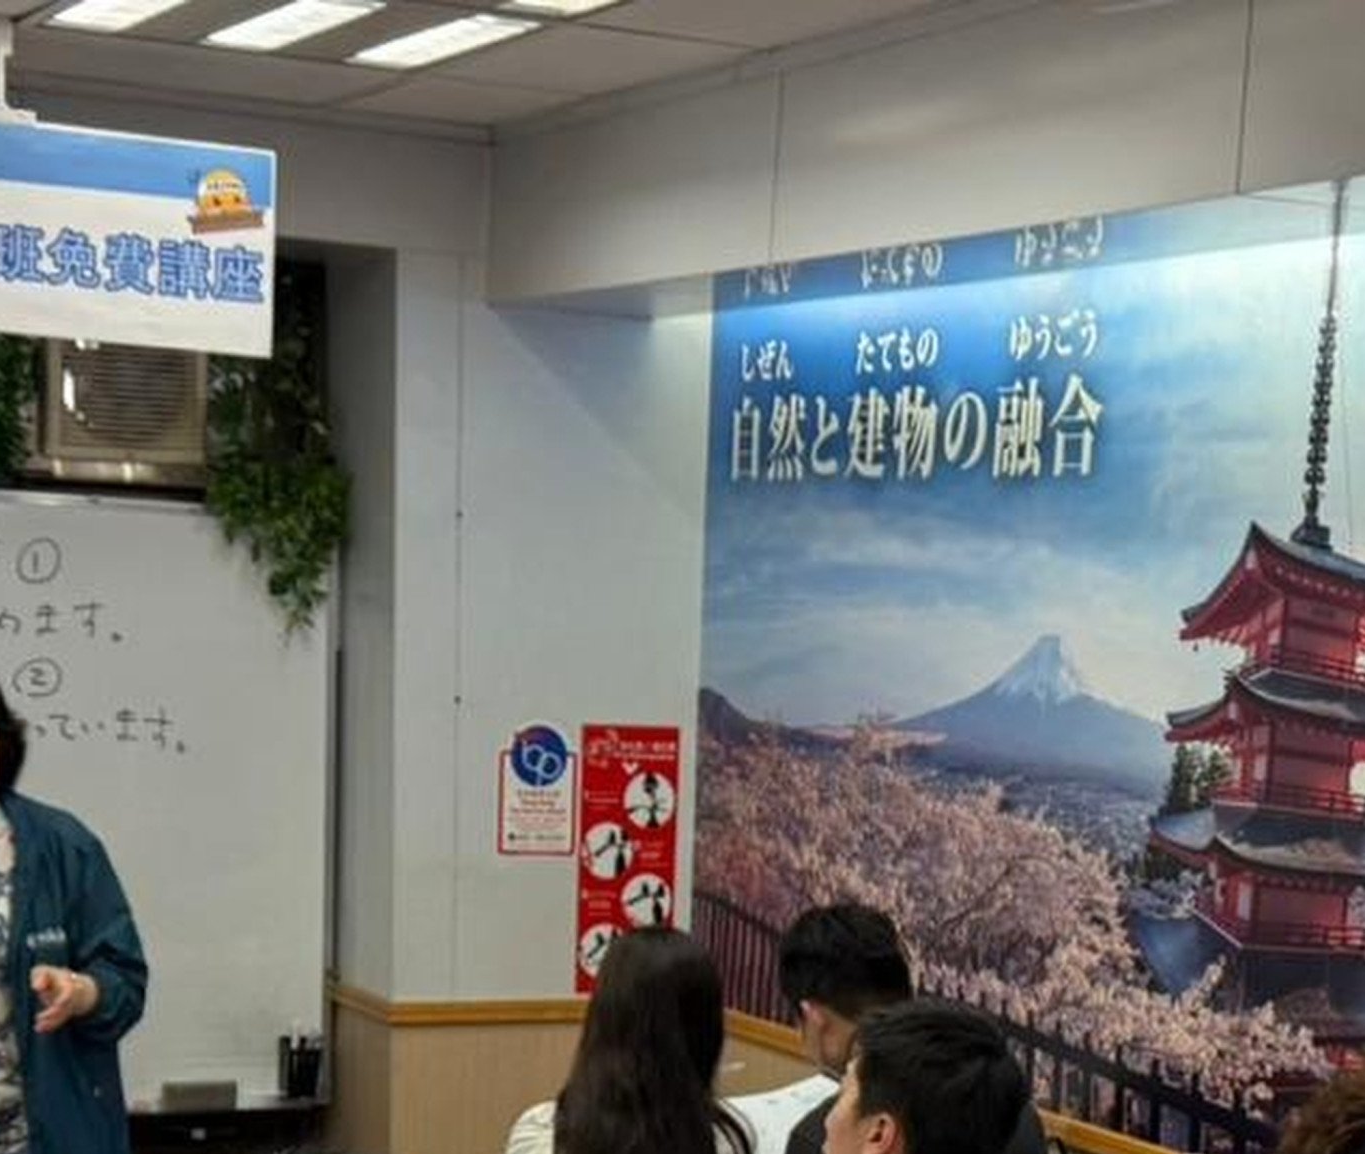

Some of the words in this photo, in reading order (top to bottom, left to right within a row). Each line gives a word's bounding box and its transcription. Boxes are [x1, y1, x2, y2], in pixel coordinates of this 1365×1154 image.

[741, 342, 792, 381] しぜん
[855, 328, 938, 375] たてもの
[1010, 309, 1097, 361] ゆうごう
[731, 374, 1104, 483] 自然と建物の融合
